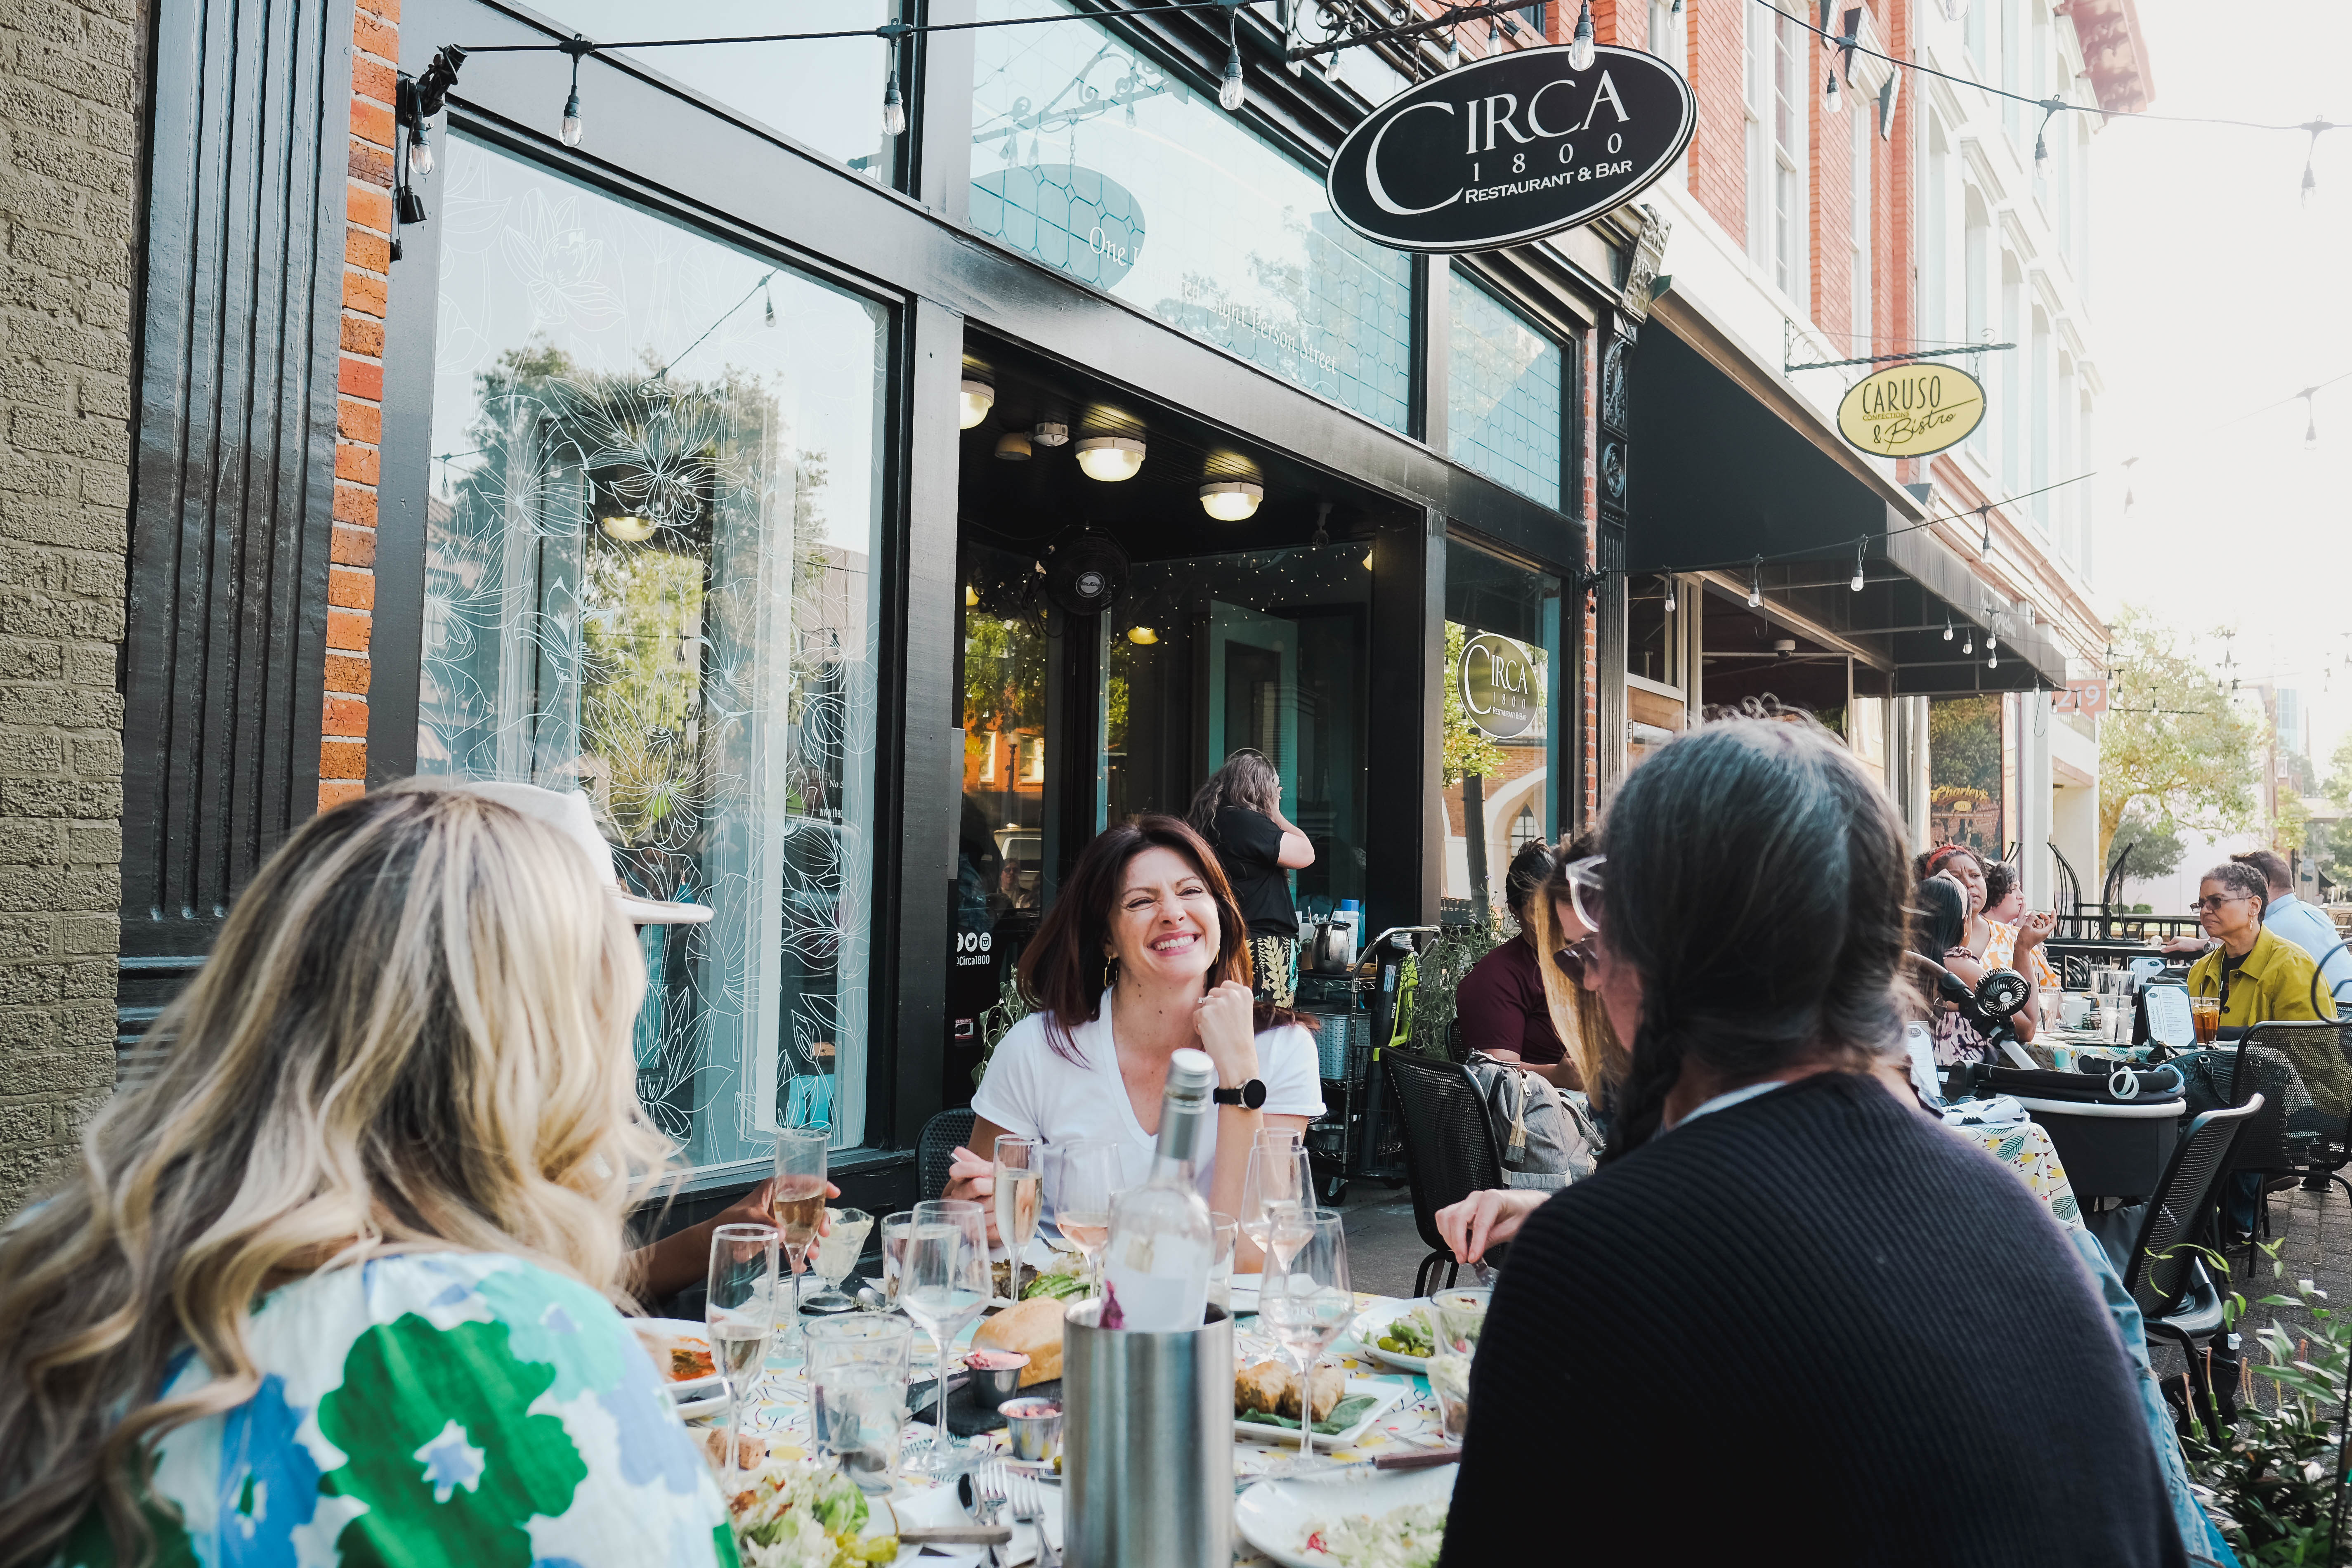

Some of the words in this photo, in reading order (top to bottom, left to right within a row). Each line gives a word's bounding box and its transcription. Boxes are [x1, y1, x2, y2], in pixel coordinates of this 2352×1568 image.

[1366, 69, 1630, 215] CIRCA
[1465, 170, 1574, 204] RESTAURANT
[1577, 166, 1592, 180] &
[1595, 159, 1633, 179] BAR
[1089, 227, 1126, 266] One
[1205, 284, 1247, 330] Eight
[1251, 309, 1297, 354] Person
[1299, 335, 1337, 375] Street
[1863, 375, 1941, 414] CARUSO
[1873, 425, 1881, 444] &
[1884, 398, 1979, 453] Bistro
[1464, 644, 1528, 715] CIRCA
[1492, 706, 1516, 720] RESTAURANT
[829, 779, 839, 788] No
